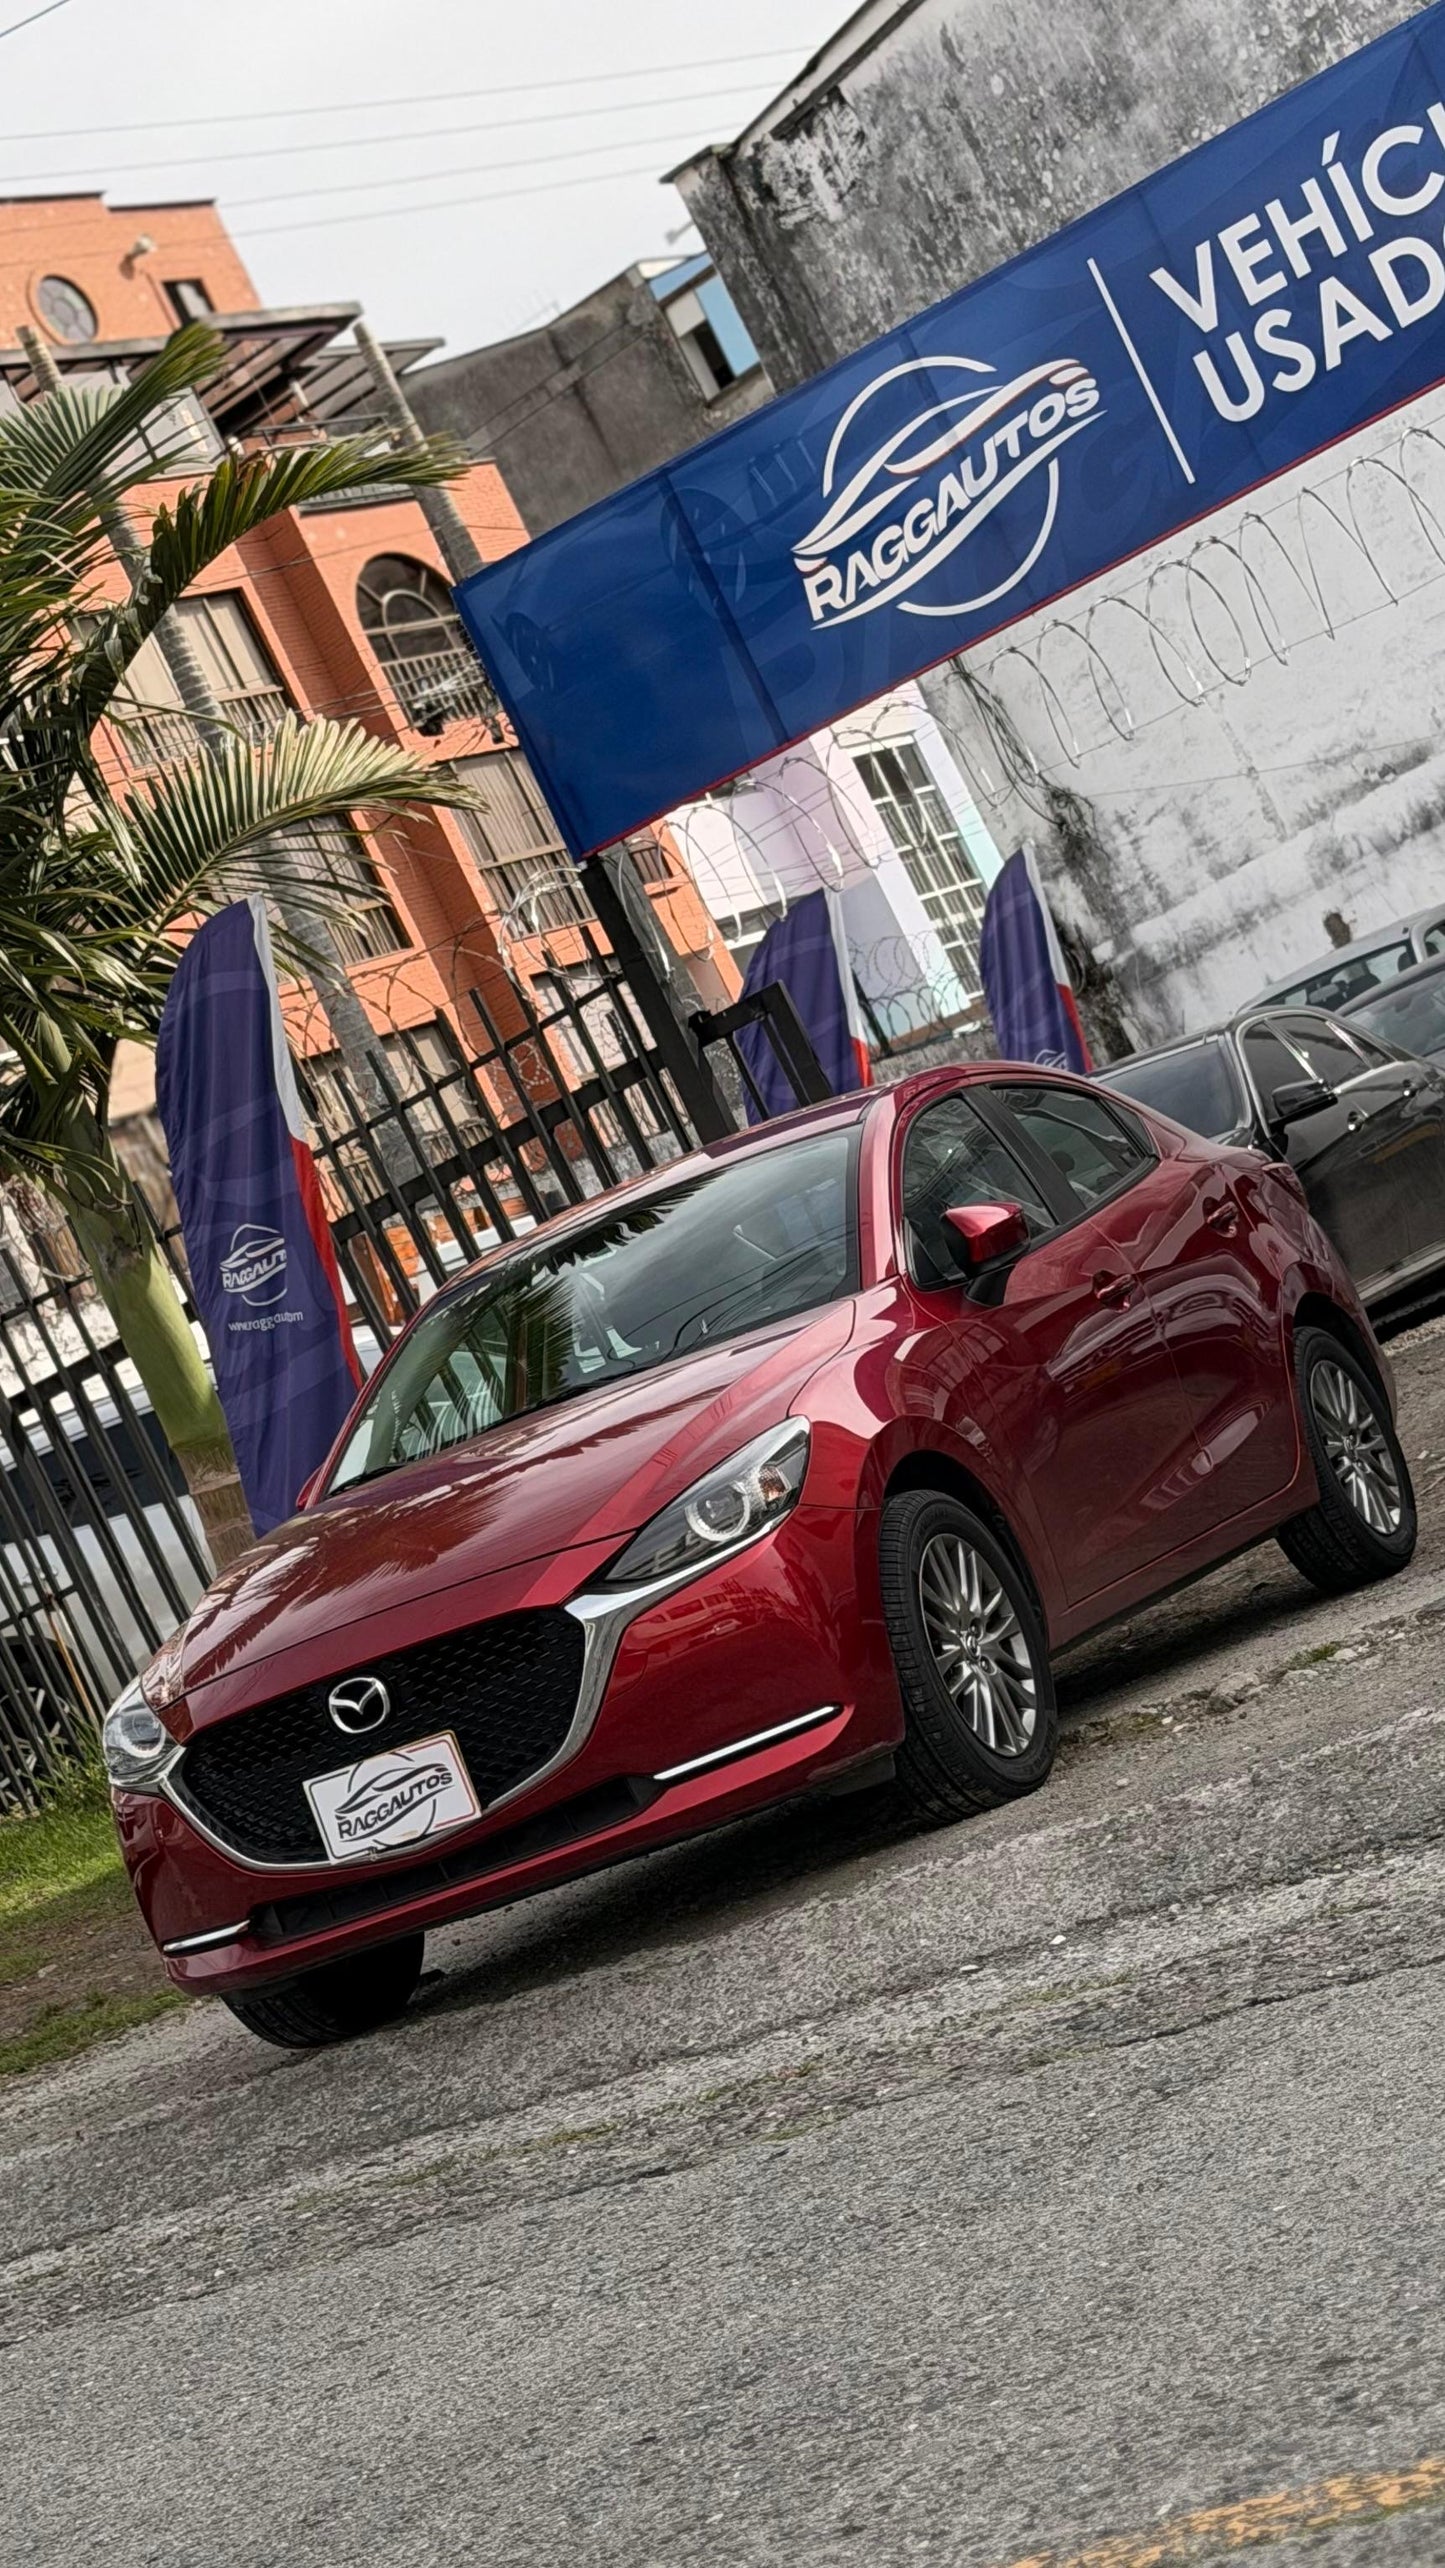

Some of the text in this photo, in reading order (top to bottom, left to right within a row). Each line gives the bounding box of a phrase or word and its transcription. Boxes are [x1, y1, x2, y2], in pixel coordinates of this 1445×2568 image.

[1149, 101, 1445, 333] VEHÍC
[1192, 222, 1445, 423] USAD
[802, 377, 1100, 620] RAGGAUTOS
[338, 1771, 453, 1839] RAGGAUTOS
